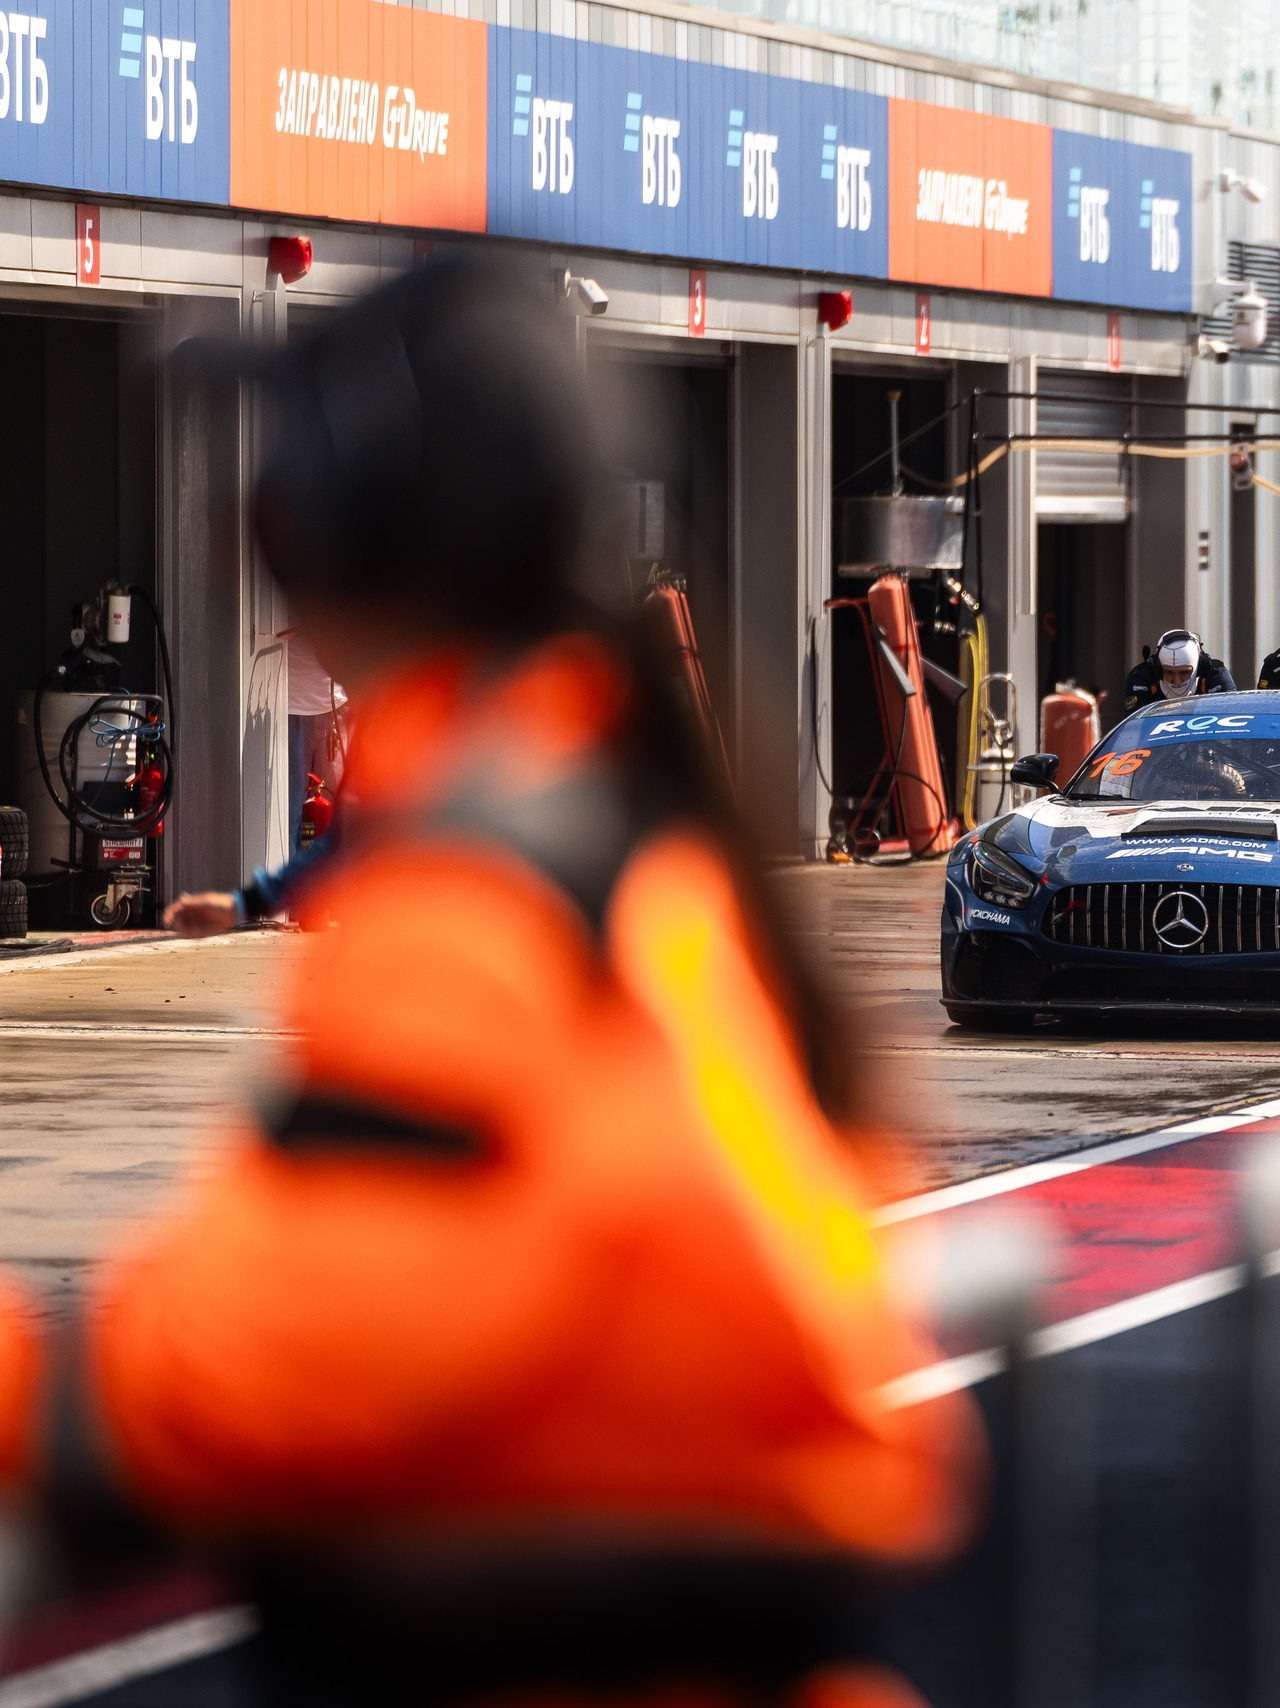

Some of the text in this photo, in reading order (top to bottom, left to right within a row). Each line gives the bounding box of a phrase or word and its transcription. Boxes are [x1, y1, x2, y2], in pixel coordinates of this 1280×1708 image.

[146, 35, 198, 144] ВТБ
[276, 67, 379, 146] ЗАПРАВЛЕНО
[532, 97, 574, 194] ВТБ
[643, 115, 681, 208] ВТБ
[743, 131, 779, 220] ВТБ
[837, 145, 872, 231] ВТБ
[1080, 186, 1110, 264] ВТБ
[83, 219, 94, 274] 5
[1151, 198, 1180, 273] ВТБ
[693, 278, 703, 327] 3
[919, 304, 928, 346] 2
[1089, 749, 1152, 778] 16
[970, 908, 1011, 926] YOKOHAMA
